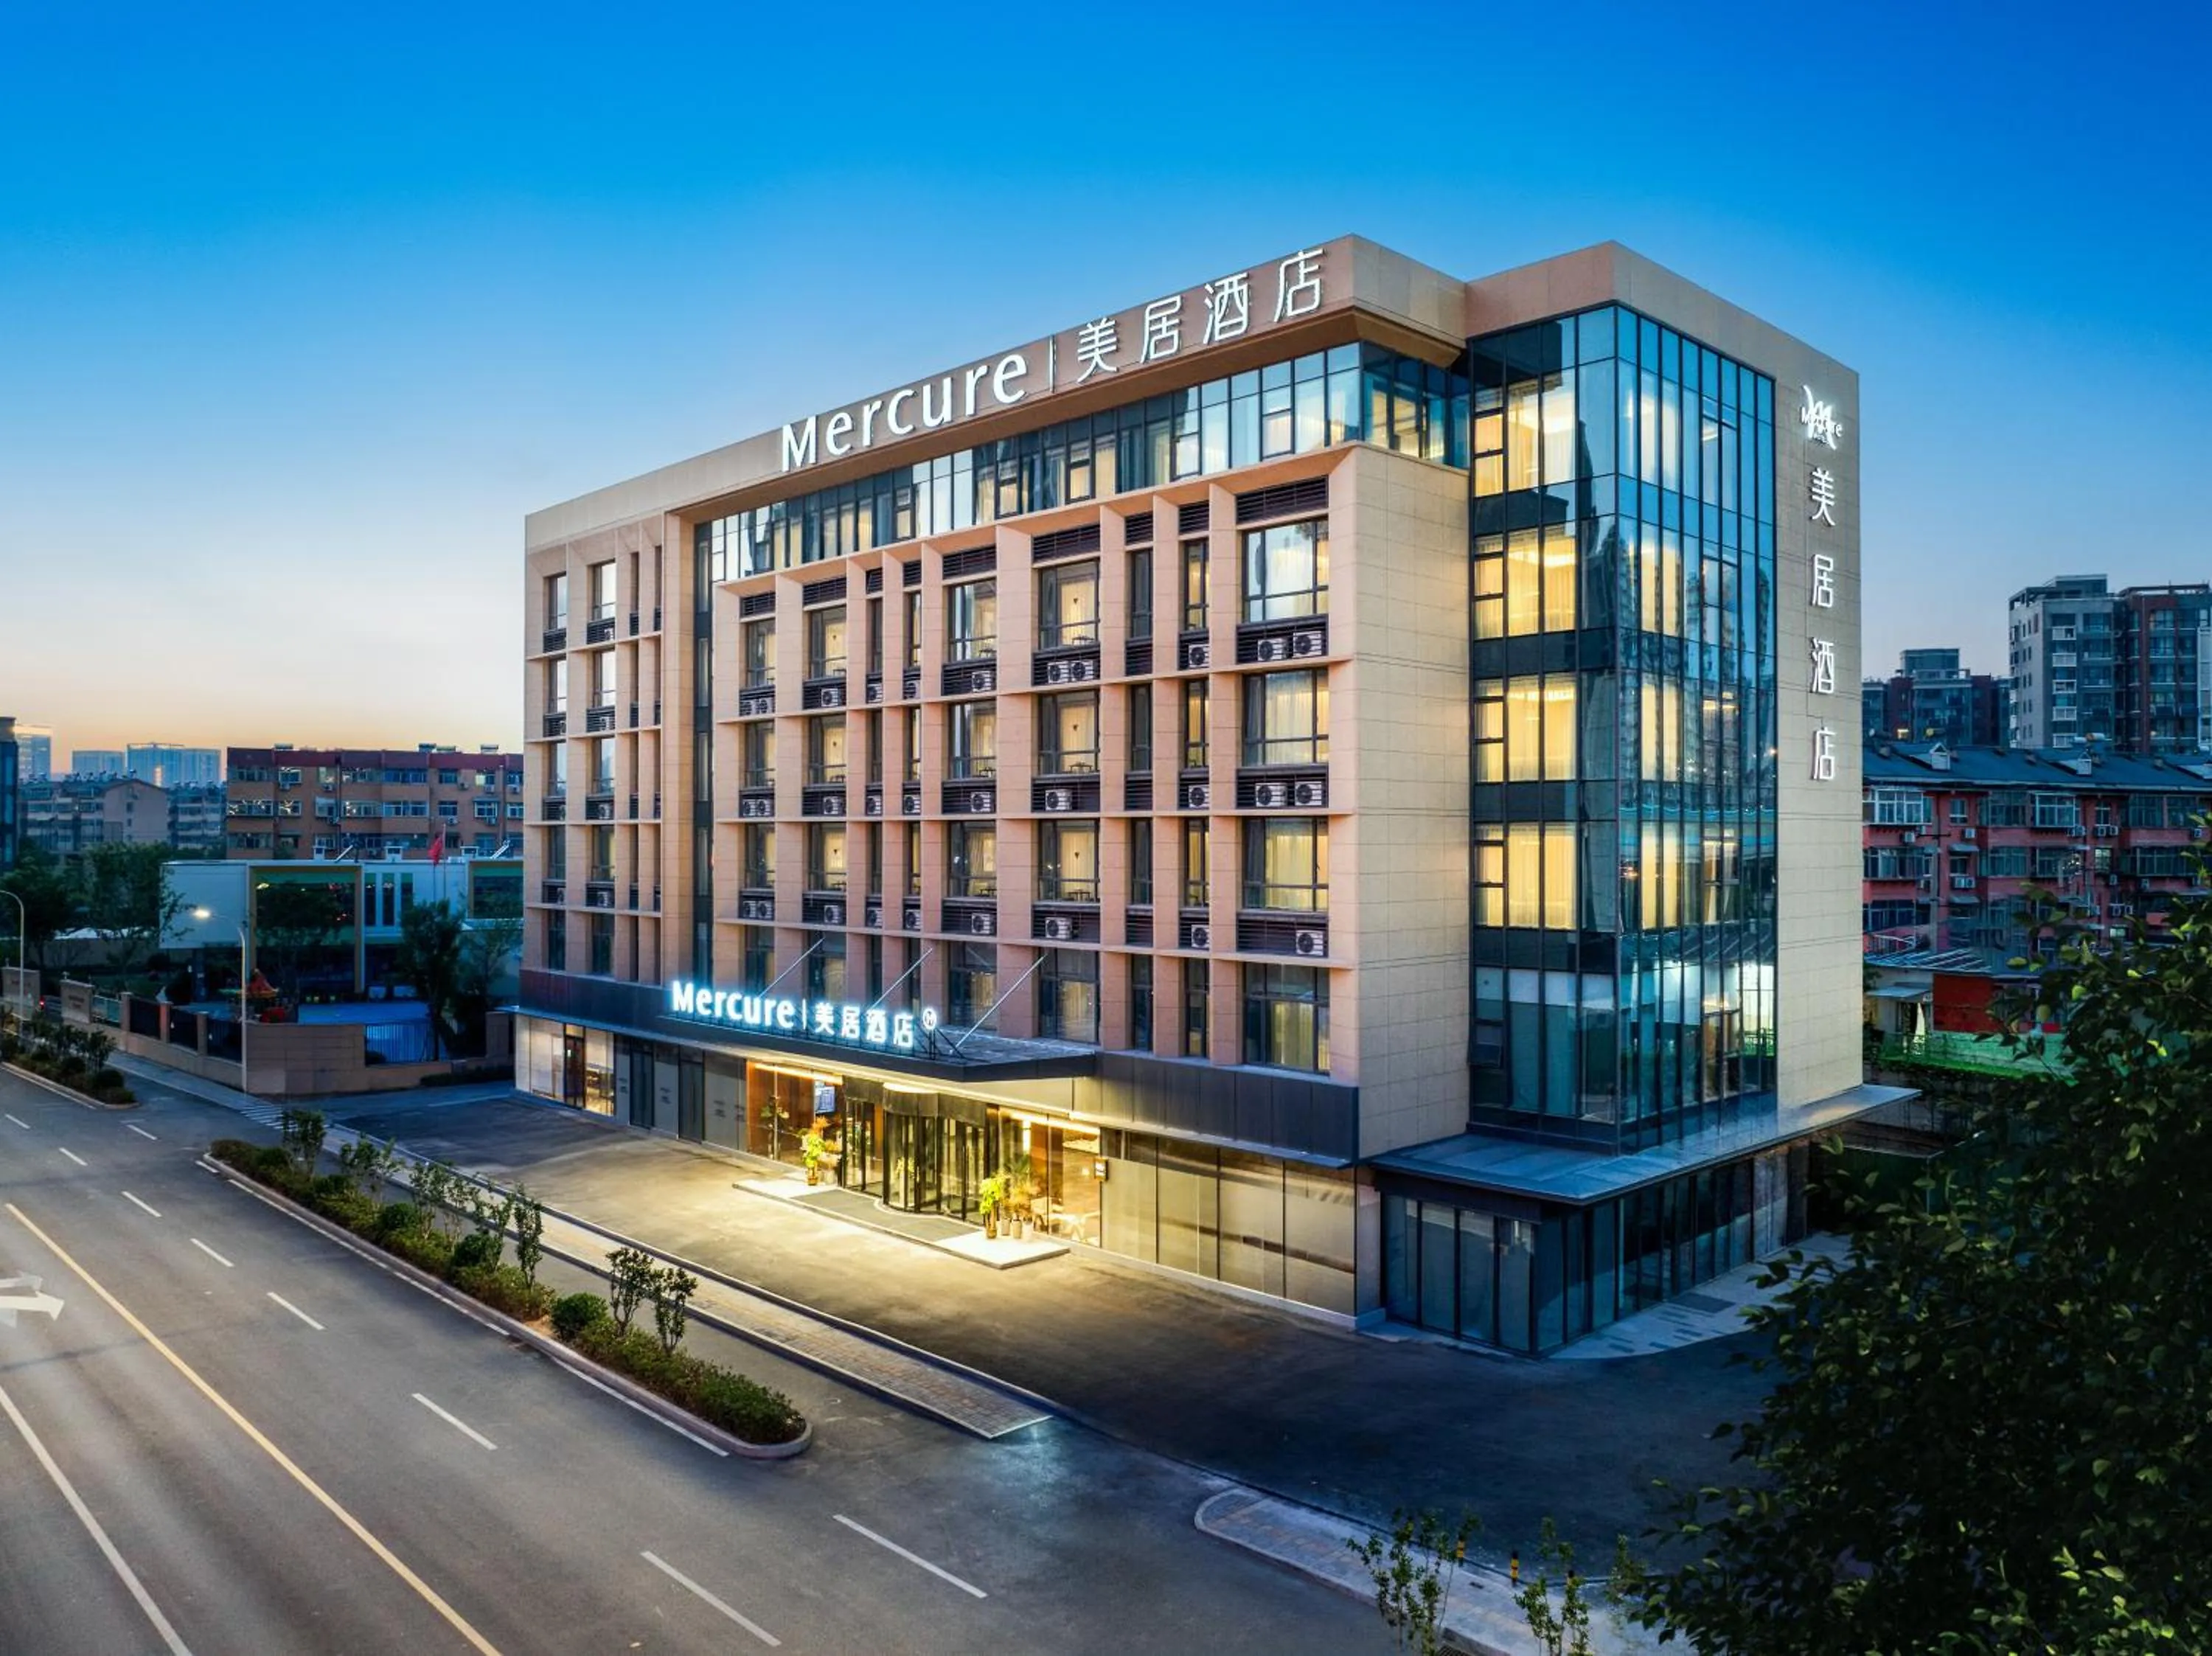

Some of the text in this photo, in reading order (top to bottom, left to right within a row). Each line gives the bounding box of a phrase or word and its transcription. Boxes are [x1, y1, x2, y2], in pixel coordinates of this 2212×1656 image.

[1077, 248, 1325, 384] 美居酒店
[782, 353, 1029, 473] Mercure
[1811, 468, 1835, 781] 美居酒店
[672, 981, 794, 1028] Mercure
[815, 1003, 914, 1047] 美居酒店
